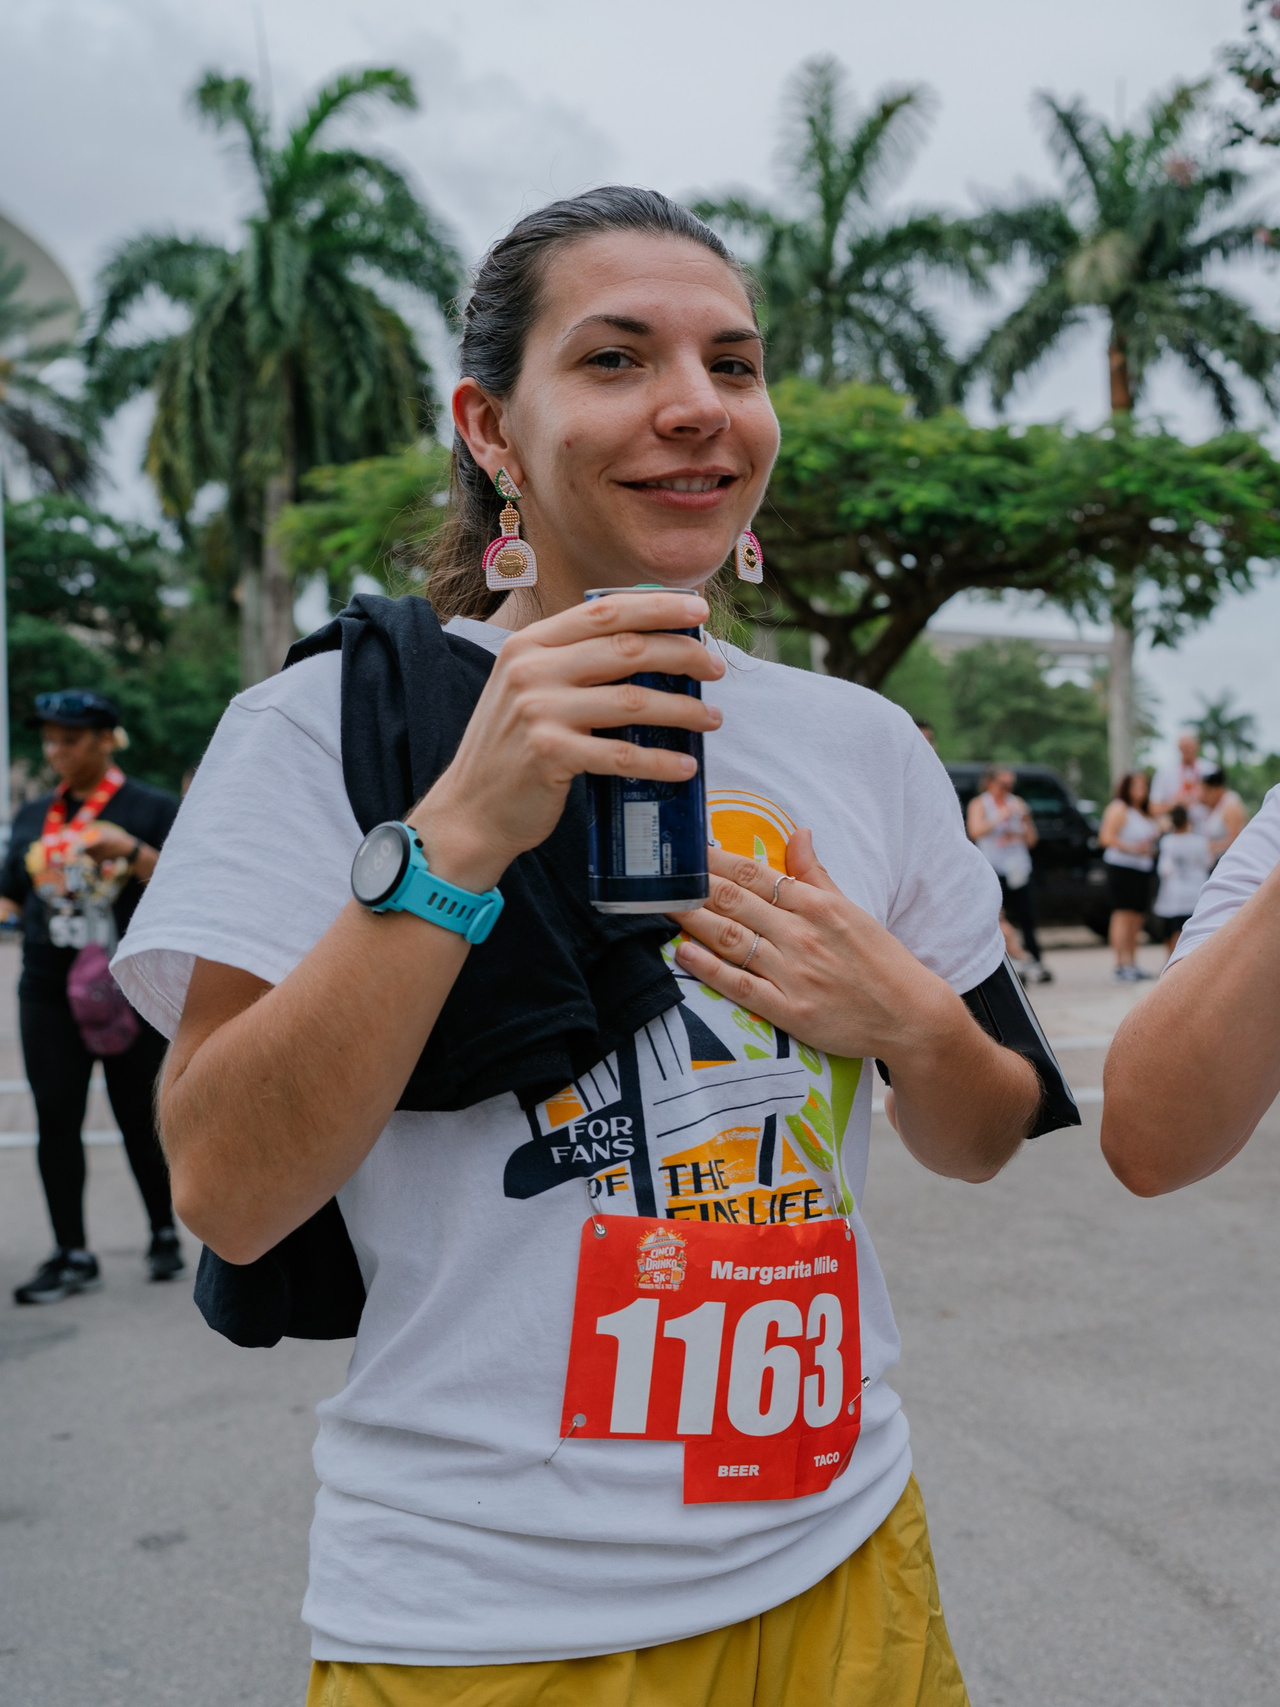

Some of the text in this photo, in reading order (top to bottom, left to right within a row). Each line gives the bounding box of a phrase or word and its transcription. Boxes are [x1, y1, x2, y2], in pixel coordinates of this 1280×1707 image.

[568, 1116, 633, 1143] FOR
[550, 1137, 636, 1164] FANS
[587, 1172, 630, 1199] OF
[658, 1159, 729, 1197] THE
[748, 1188, 822, 1225] LIFE
[645, 1258, 678, 1271] DRINKO
[710, 1255, 839, 1285] Margarita Mile
[595, 1292, 844, 1437] 1163
[717, 1464, 760, 1478] BEER
[813, 1451, 840, 1467] TACO
